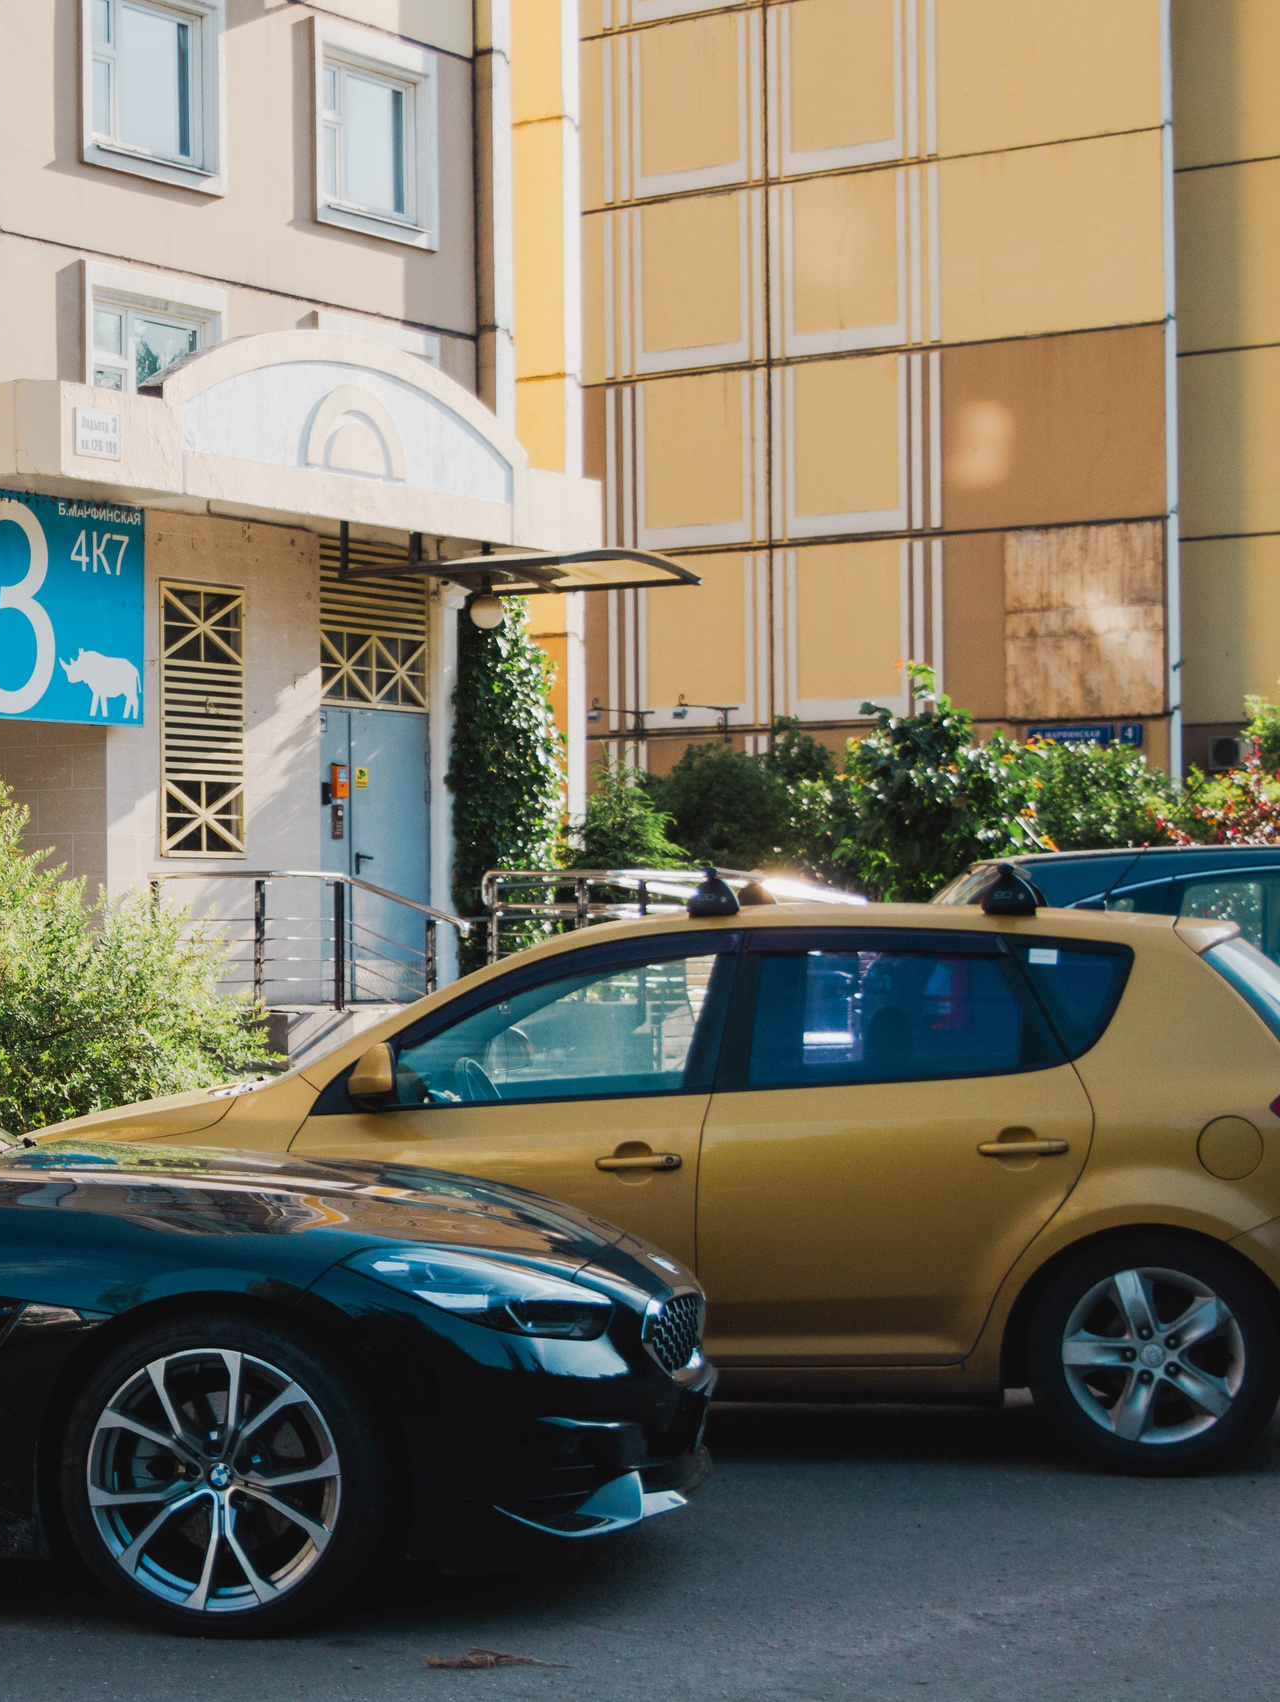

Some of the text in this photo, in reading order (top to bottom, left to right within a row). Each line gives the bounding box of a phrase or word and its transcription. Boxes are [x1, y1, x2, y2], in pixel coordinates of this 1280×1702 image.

[111, 416, 117, 434] 3
[58, 502, 141, 526] Б.МАРФИНСКАЯ
[1124, 726, 1134, 739] 4
